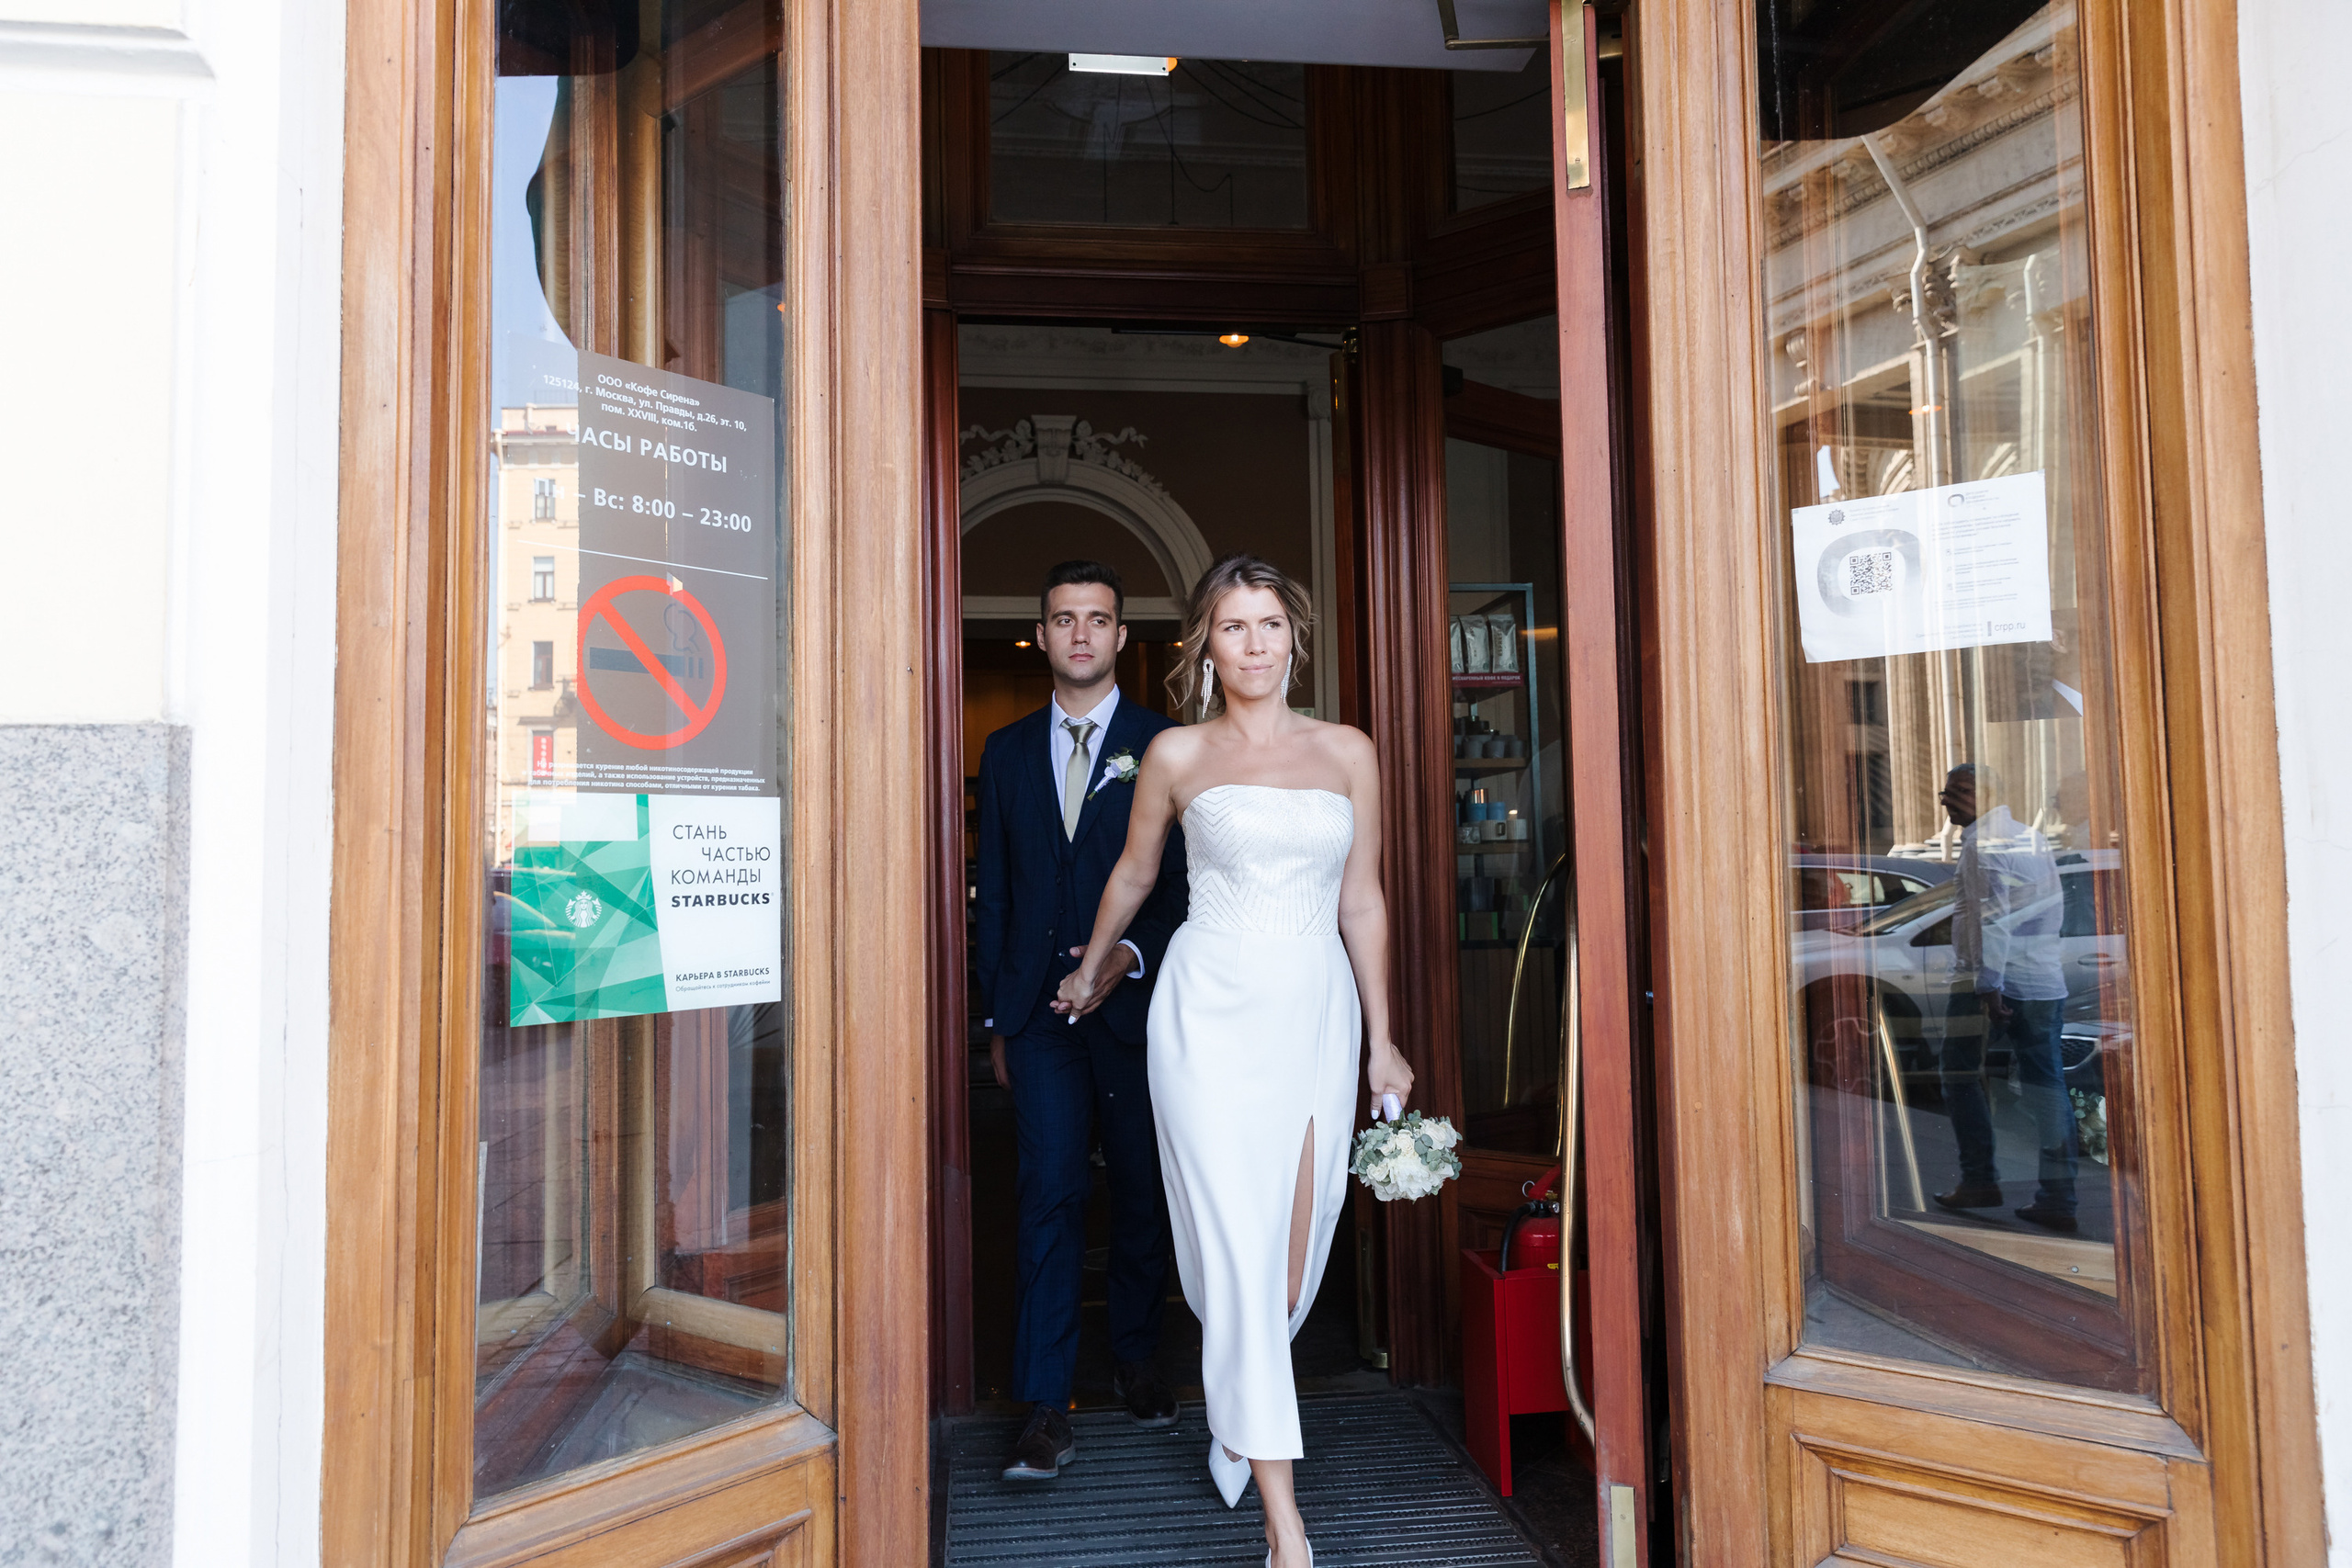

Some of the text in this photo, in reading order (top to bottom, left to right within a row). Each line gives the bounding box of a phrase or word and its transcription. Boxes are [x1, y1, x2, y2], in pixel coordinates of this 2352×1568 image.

[598, 374, 700, 406] ООО «Кофе Сирена»
[543, 374, 747, 432] 125124, г. Москва, ул. Правды, д.26, эт. 10,
[601, 402, 626, 415] пом.
[566, 422, 728, 473] ЧАСЫ РАБОТЫ
[594, 487, 624, 510] Вс:
[631, 495, 676, 519] 8:00
[700, 507, 752, 533] 23:00
[1994, 621, 2026, 632] crpp.ru
[595, 763, 625, 773] курение
[650, 765, 719, 774] никотиносодержащей
[720, 768, 753, 776] продукции
[626, 781, 664, 789] способами,
[664, 783, 702, 791] отличными
[627, 773, 676, 782] использование
[677, 775, 710, 784] устройств,
[673, 824, 727, 840] СТАНЬ
[701, 846, 771, 862] ЧАСТЬЮ
[671, 868, 761, 886] КОМАНДЫ
[671, 893, 770, 908] STARBUCKS
[675, 972, 715, 982] КАРЬЕРА
[724, 967, 770, 978] STARBUCKS
[675, 984, 711, 993] Обращайтесь
